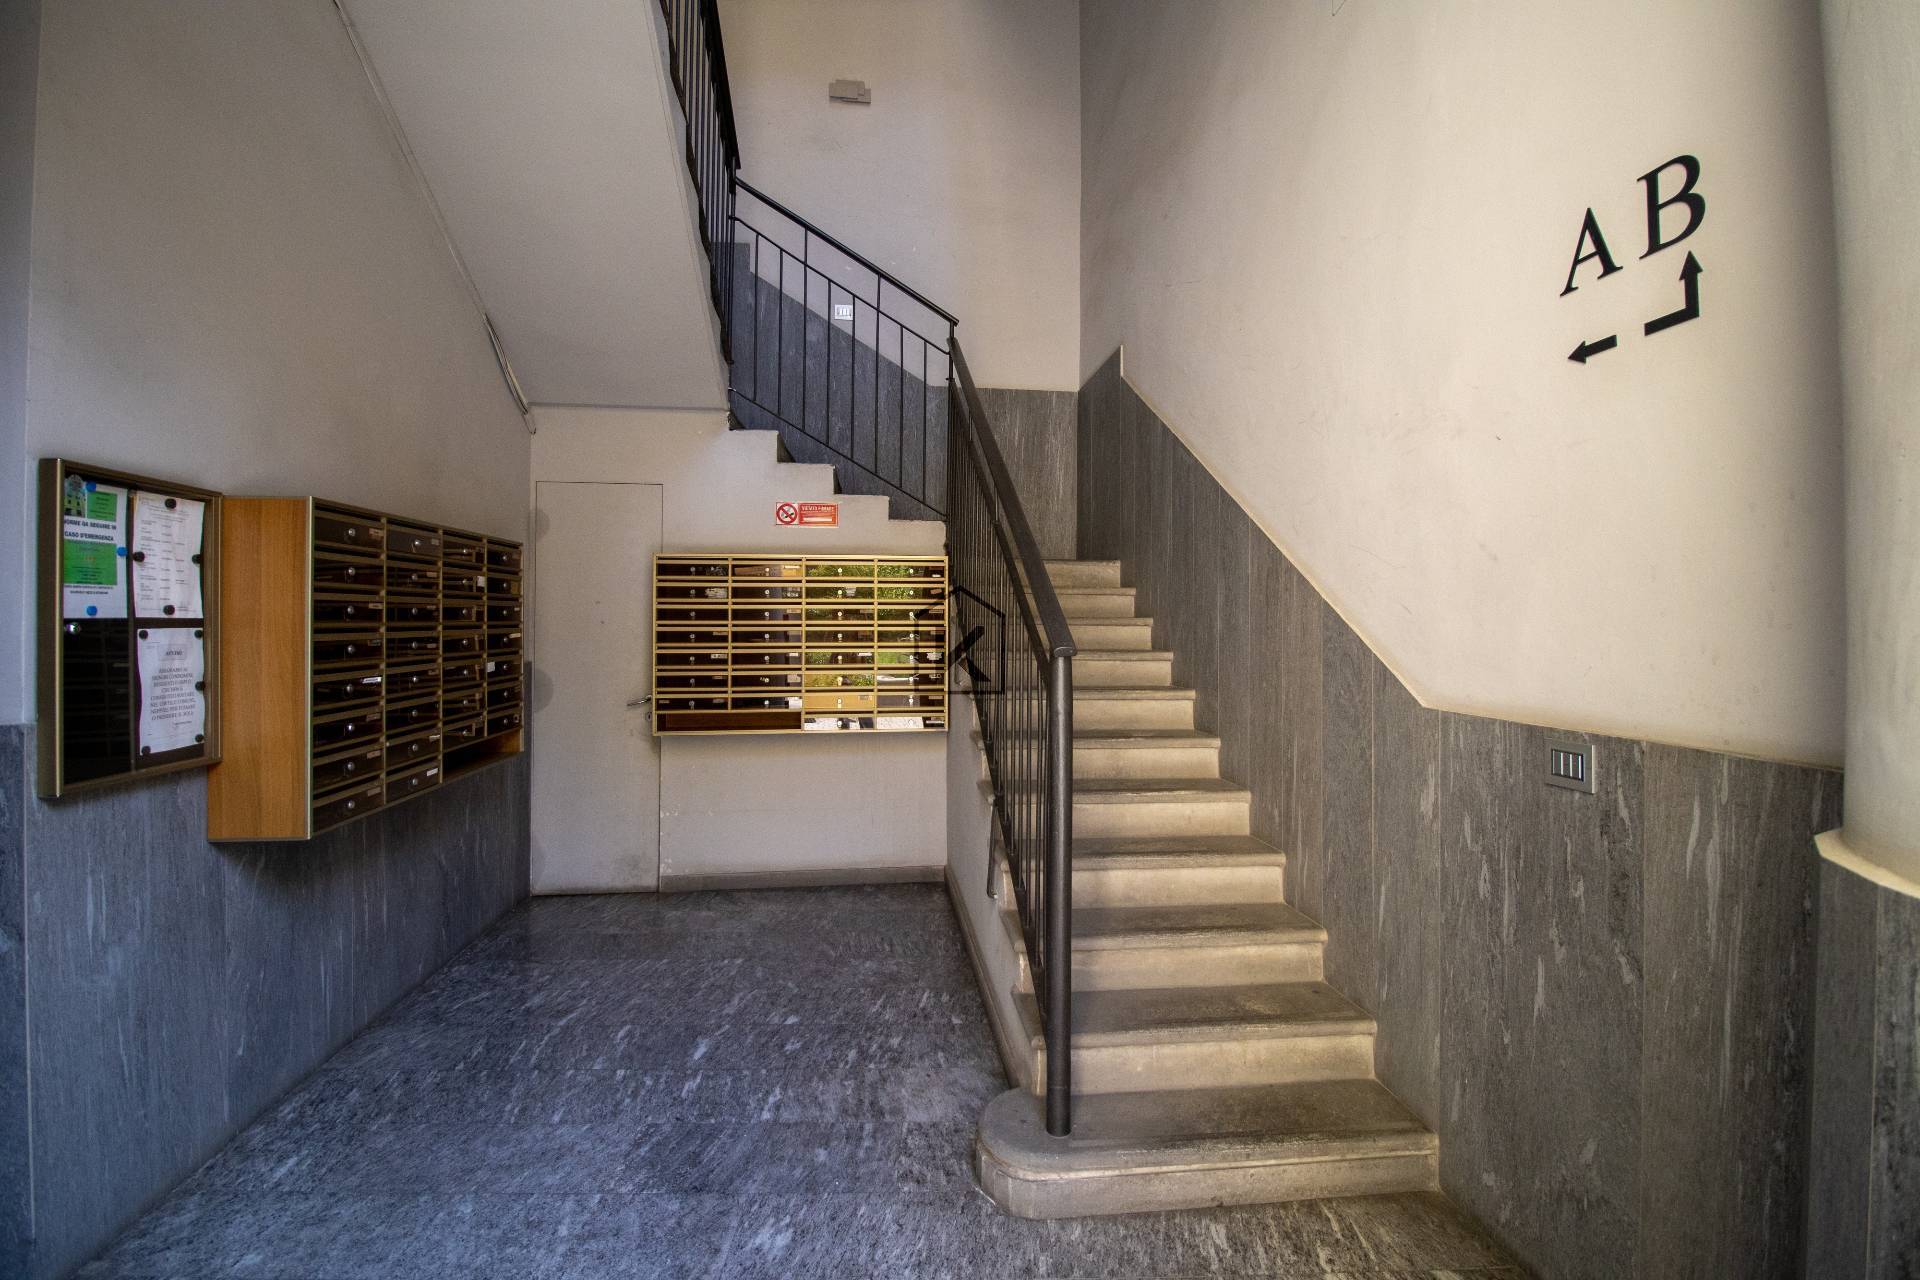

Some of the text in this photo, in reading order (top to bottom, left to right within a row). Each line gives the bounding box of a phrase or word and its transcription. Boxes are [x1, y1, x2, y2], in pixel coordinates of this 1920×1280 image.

[1559, 154, 1706, 298] A B
[64, 530, 79, 538] CASO
